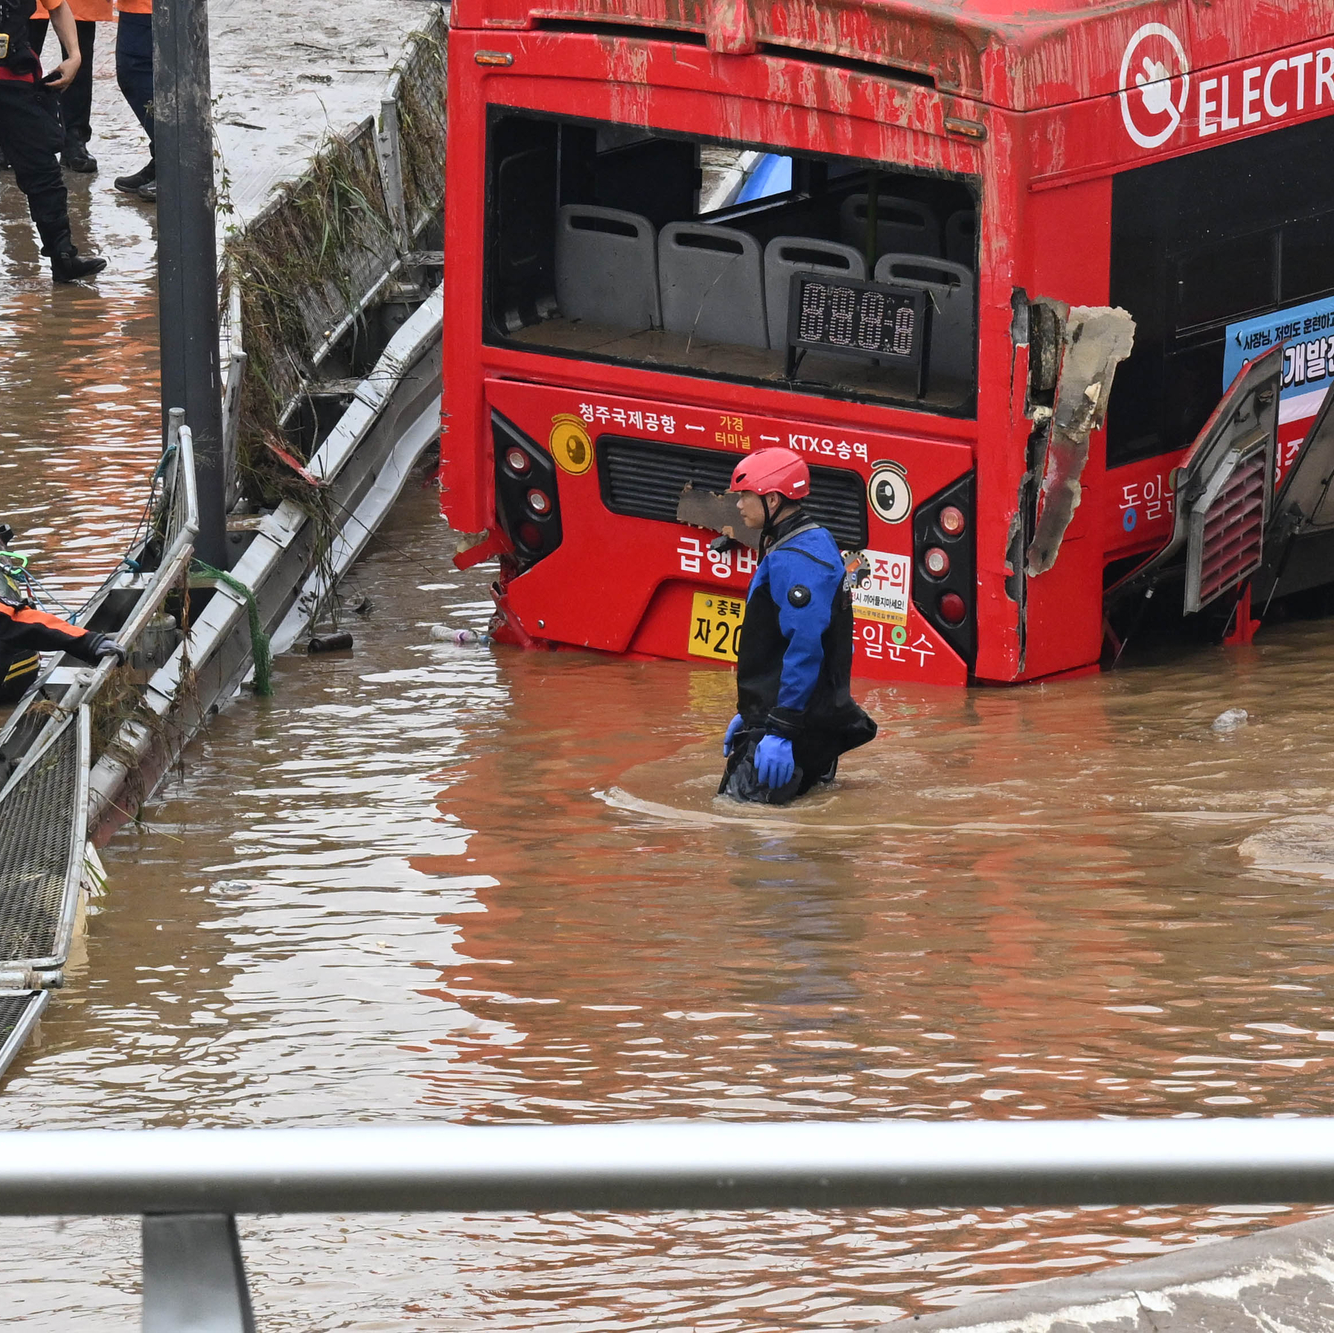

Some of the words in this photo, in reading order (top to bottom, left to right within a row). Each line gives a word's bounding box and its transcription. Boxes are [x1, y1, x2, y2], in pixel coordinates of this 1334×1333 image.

[1243, 330, 1273, 351] 사장님,
[578, 402, 677, 434] 청주국제공항
[720, 416, 744, 431] 가경
[788, 433, 869, 463] KTX오송역
[715, 431, 751, 450] 터미널
[873, 558, 907, 595] 주의
[716, 599, 740, 619] 충북
[693, 617, 712, 644] 자
